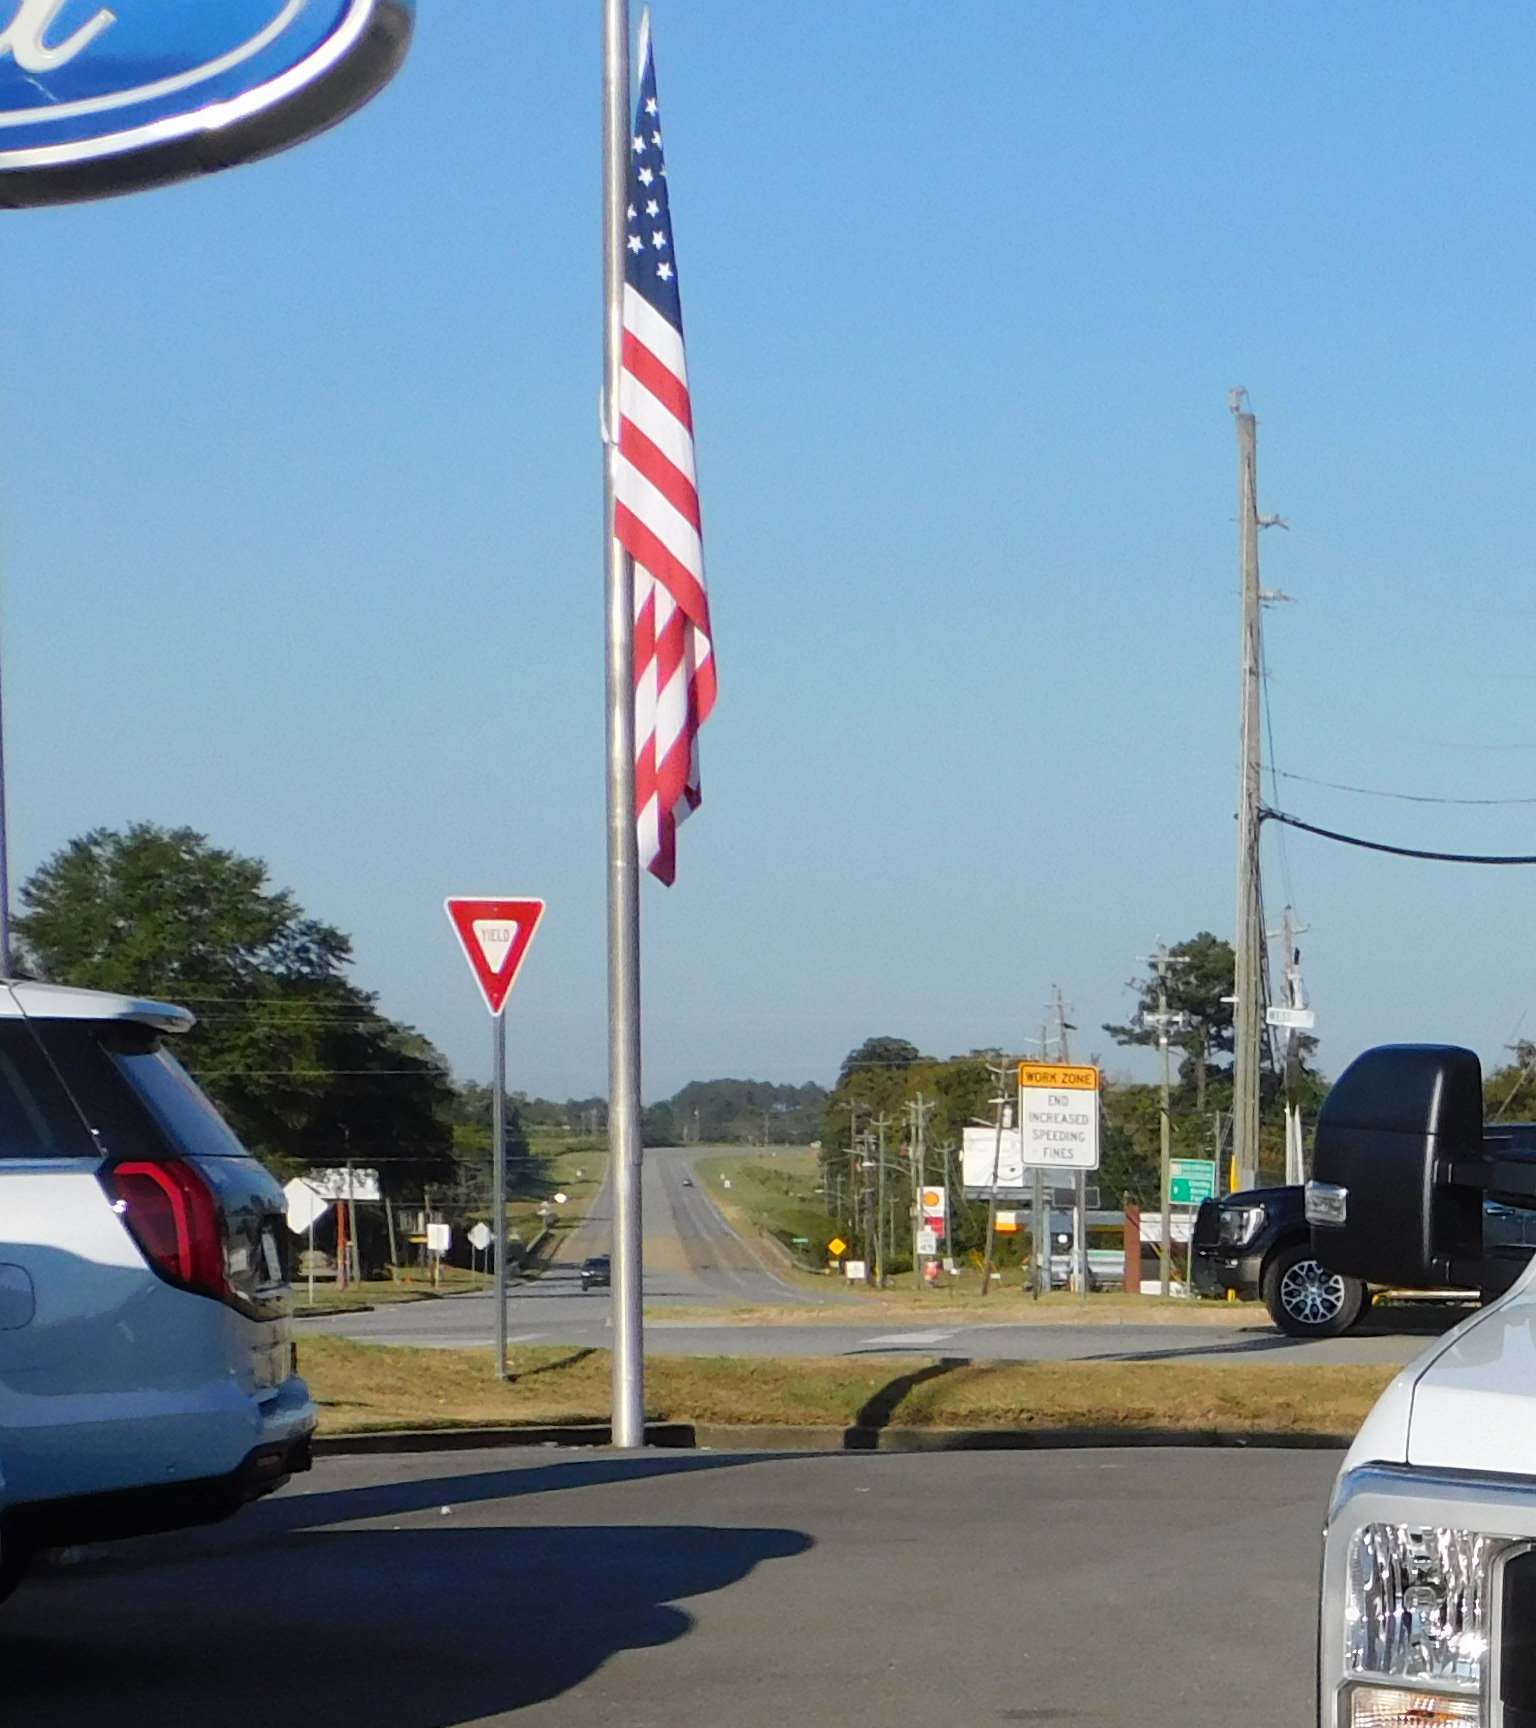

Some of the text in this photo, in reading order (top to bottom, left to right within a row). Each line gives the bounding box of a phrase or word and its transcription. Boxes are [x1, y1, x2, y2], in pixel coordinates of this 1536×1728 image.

[481, 928, 510, 942] YIELD
[1026, 1072, 1093, 1085] WORK ZONE
[1048, 1095, 1069, 1107] END
[1028, 1112, 1089, 1125] INCREASED
[1032, 1129, 1086, 1142] SPEEDING
[1043, 1147, 1074, 1160] FINES
